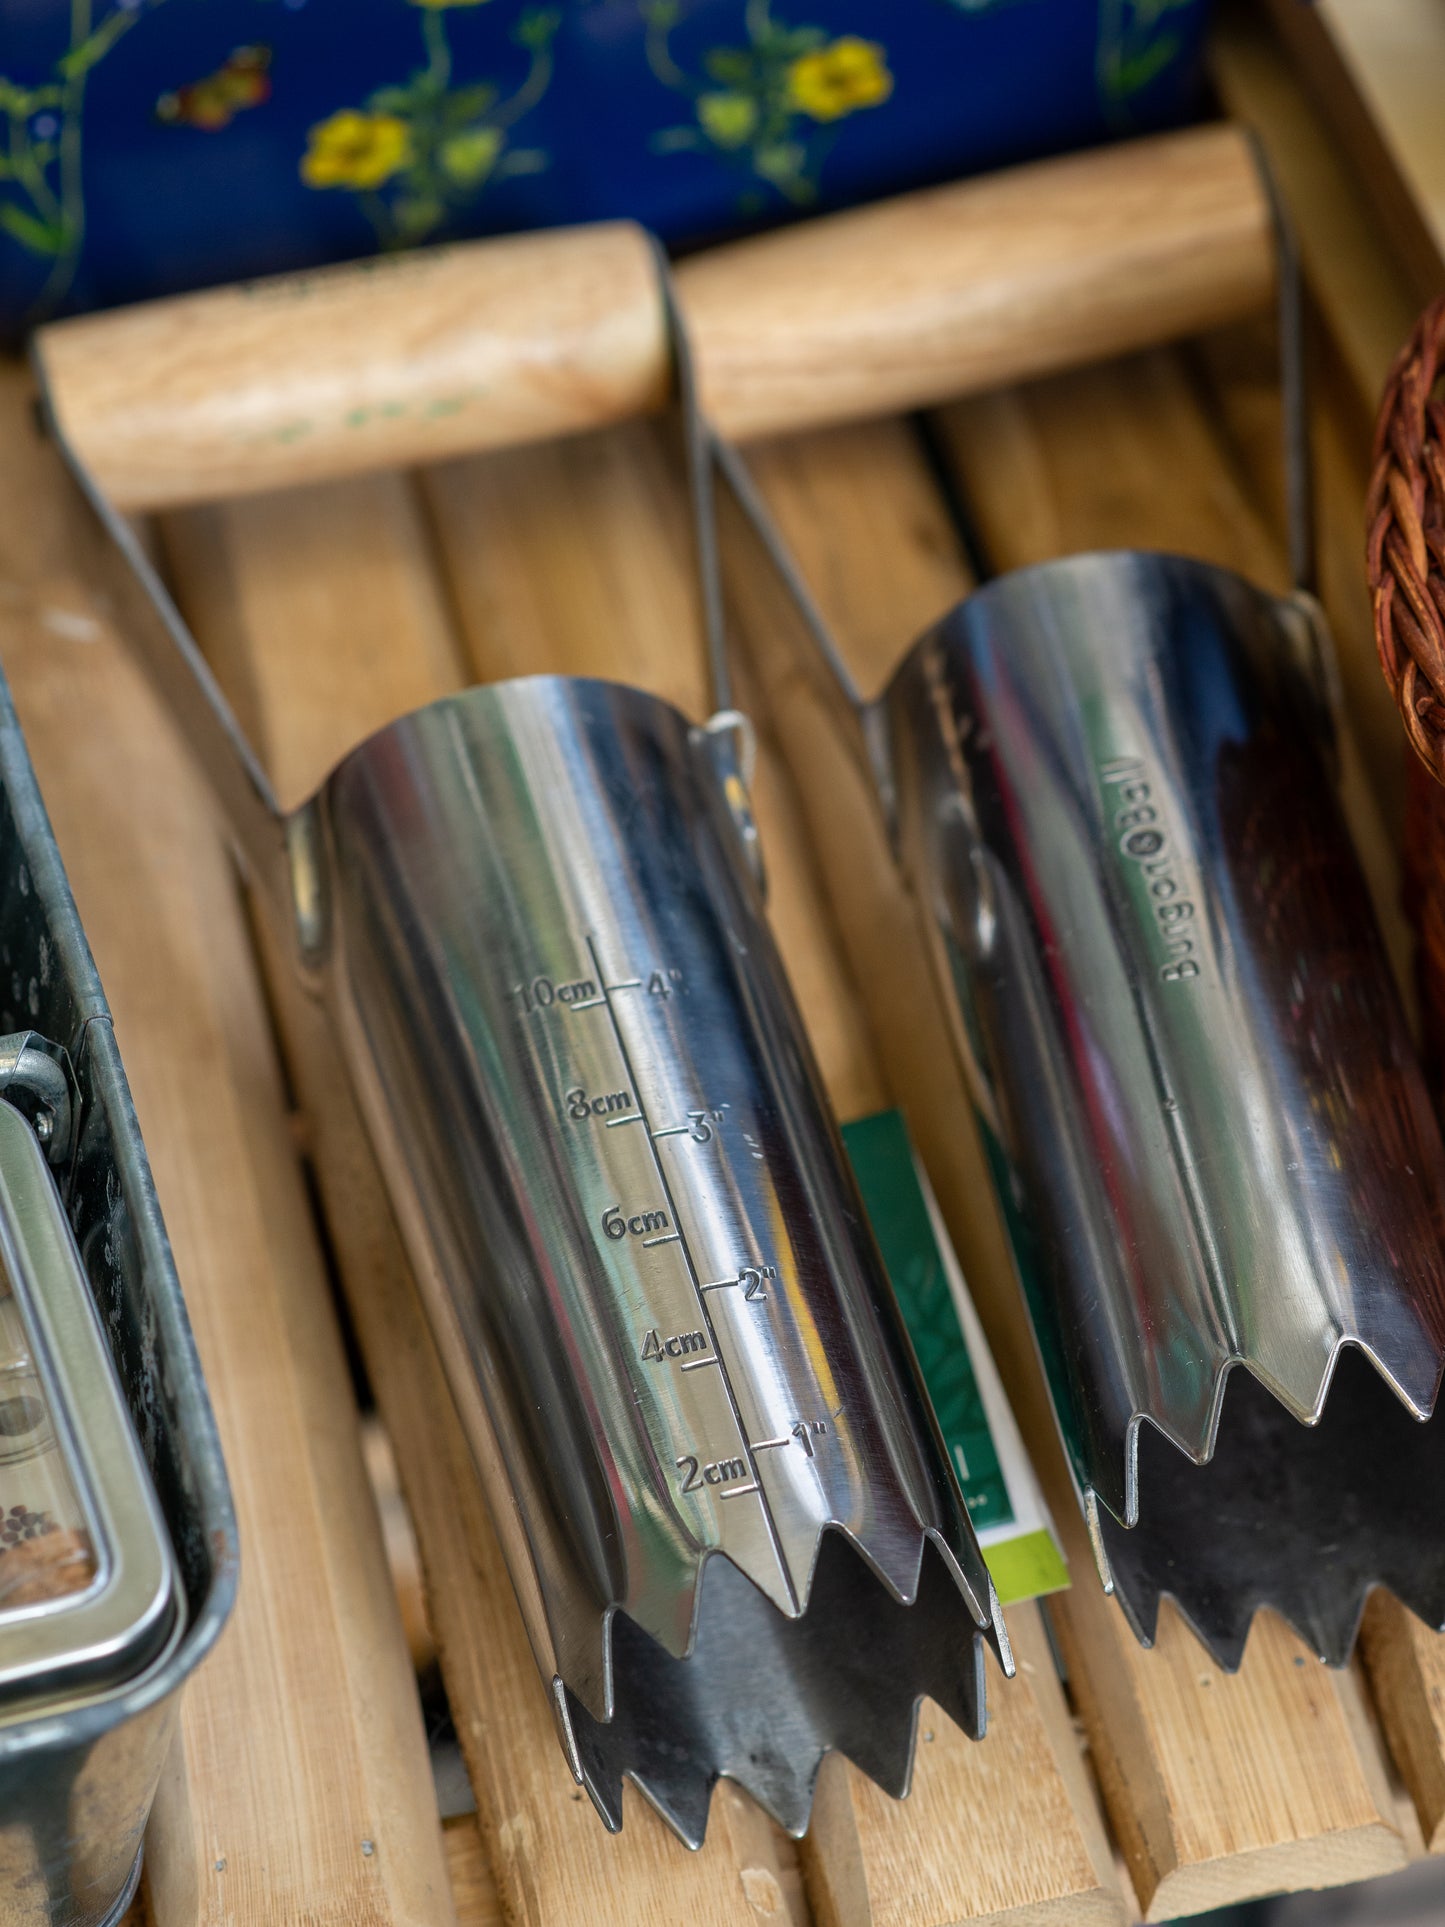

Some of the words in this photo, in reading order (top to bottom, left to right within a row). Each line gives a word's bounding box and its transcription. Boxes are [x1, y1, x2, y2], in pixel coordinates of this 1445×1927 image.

[1145, 858, 1199, 981] Burgon
[514, 976, 596, 1013] 10cm
[566, 1087, 632, 1120] 8cm
[602, 1205, 669, 1240] 6cm
[738, 1266, 777, 1301] 2"
[641, 1328, 707, 1363] 4cm
[675, 1455, 747, 1494] 2cm
